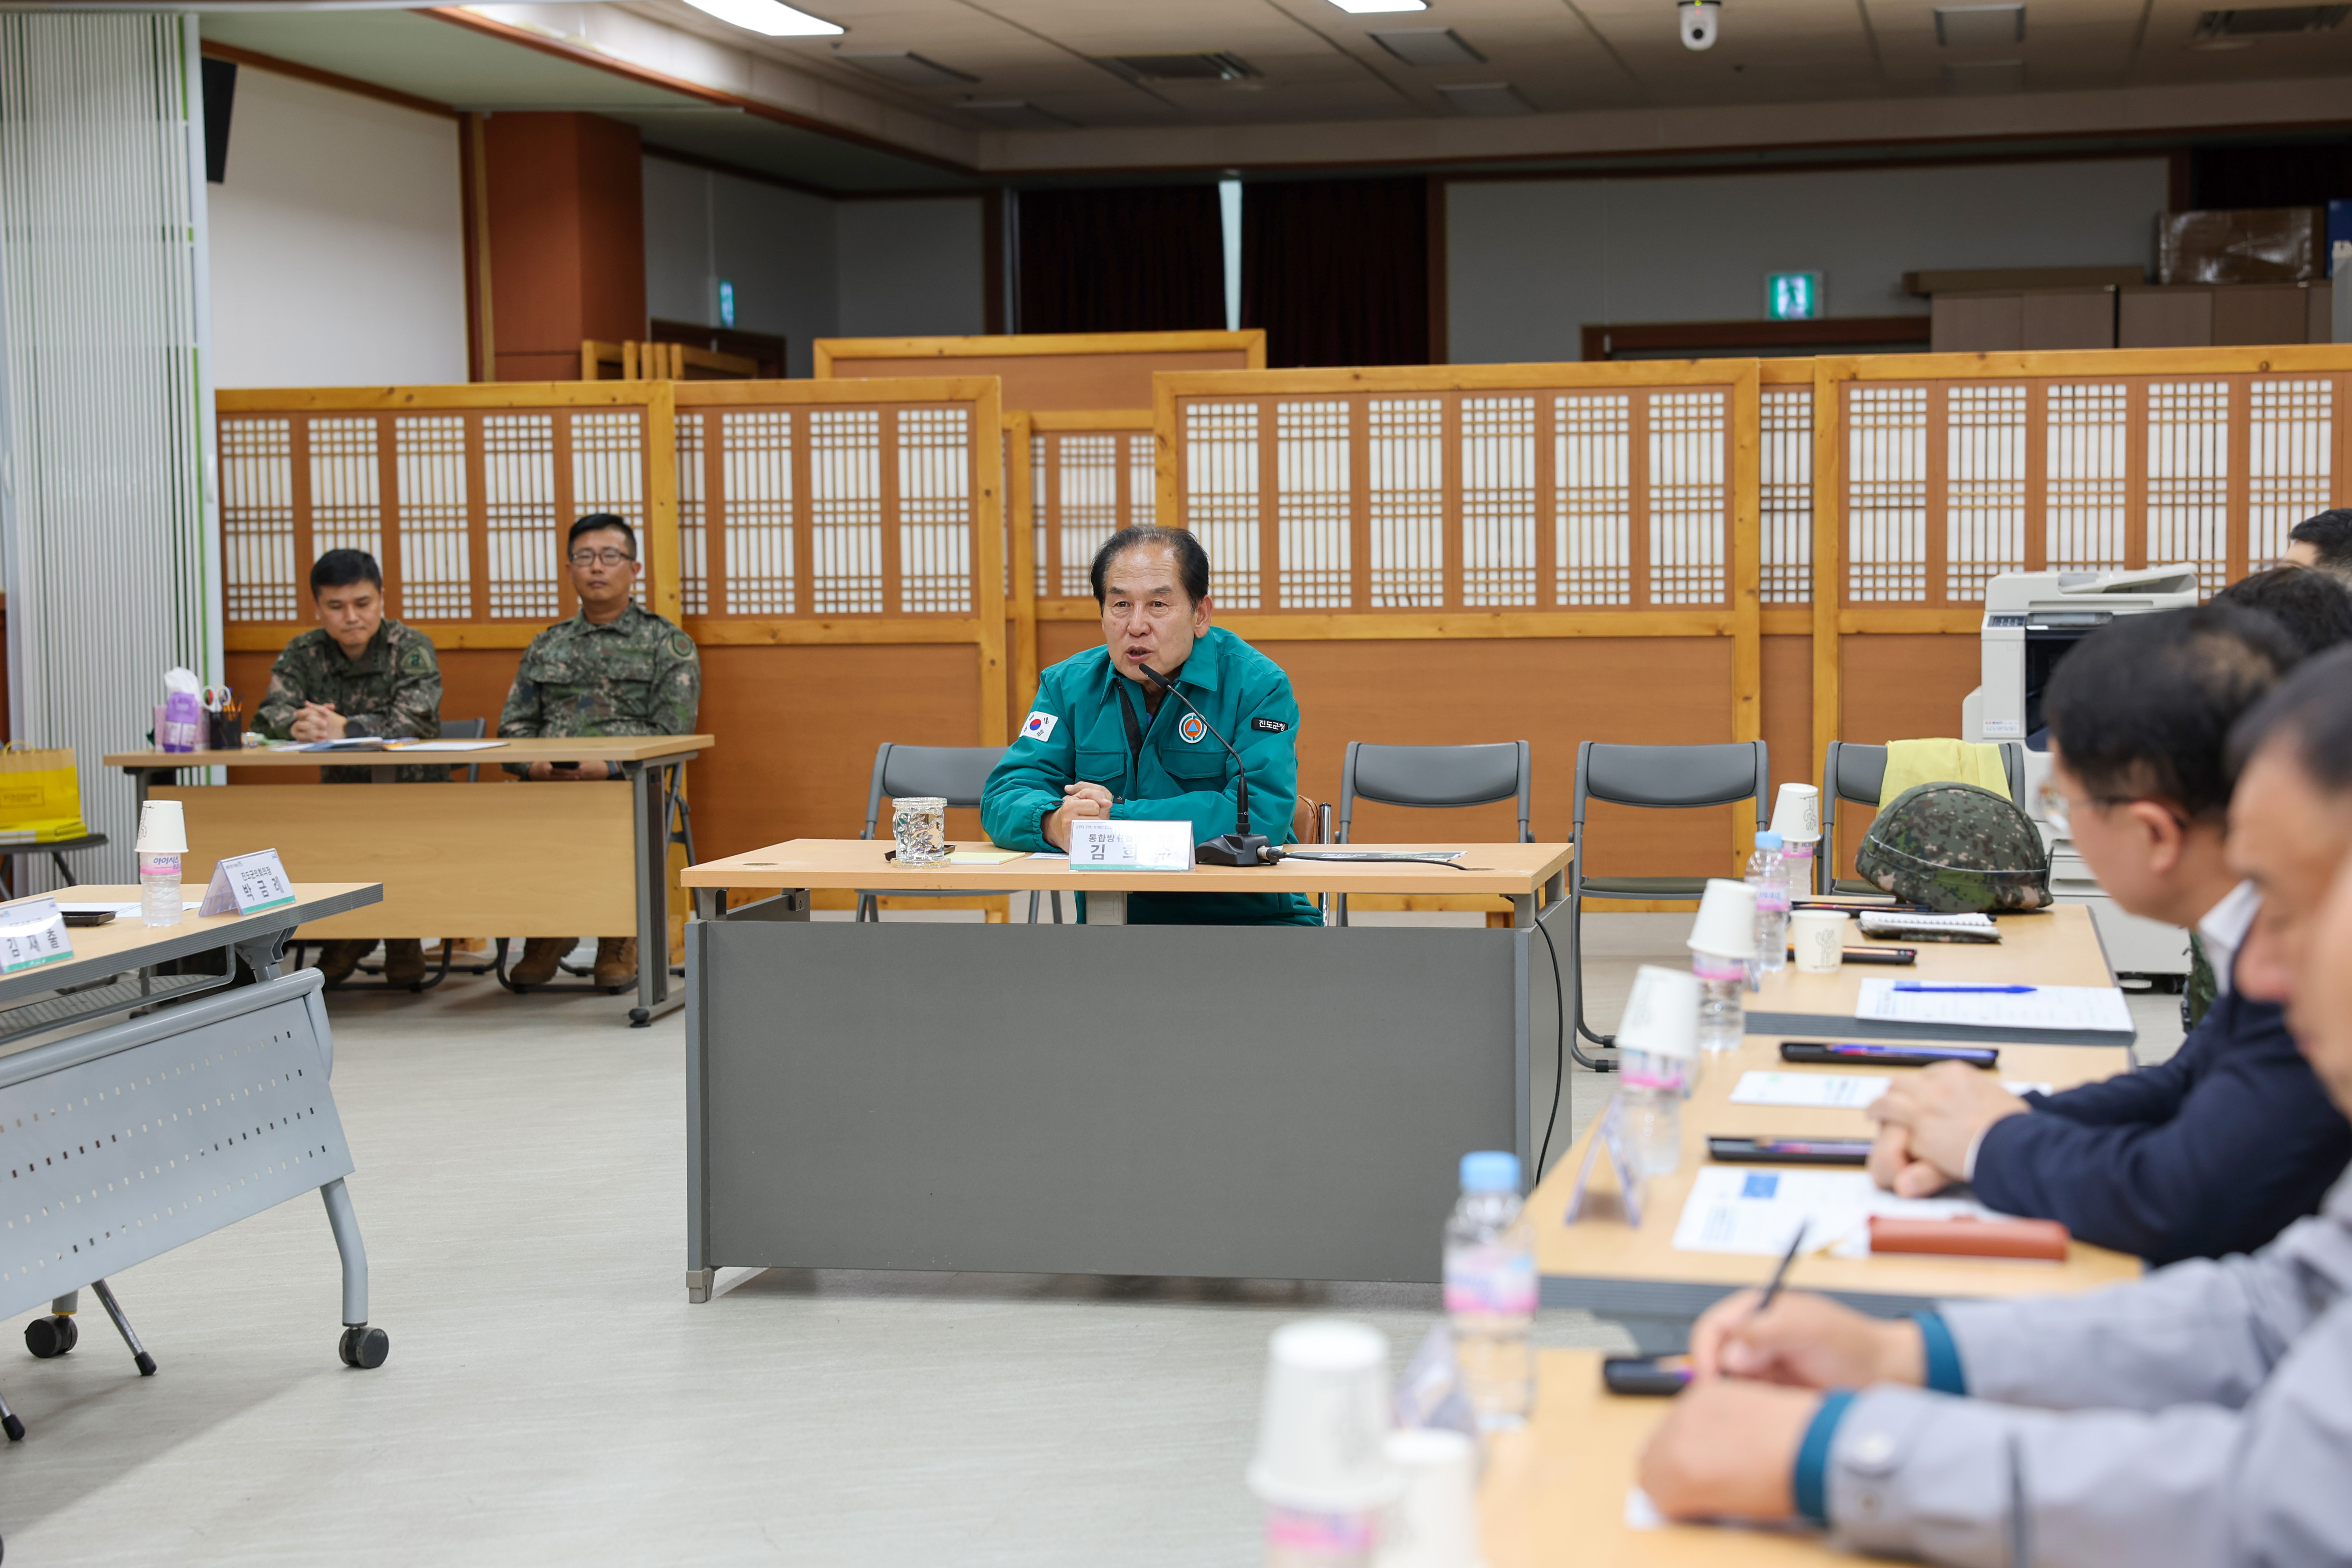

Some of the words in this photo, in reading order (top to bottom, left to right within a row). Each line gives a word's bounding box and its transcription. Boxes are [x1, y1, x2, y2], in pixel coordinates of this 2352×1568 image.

[1259, 720, 1285, 731] 진도군청
[1088, 833, 1152, 843] 통합방위협의회
[1090, 844, 1105, 860] 김
[153, 856, 179, 865] 아이시스
[241, 866, 272, 881] 진도군의회의장
[242, 883, 255, 901] 박
[257, 880, 270, 898] 금
[6, 937, 20, 958] 김
